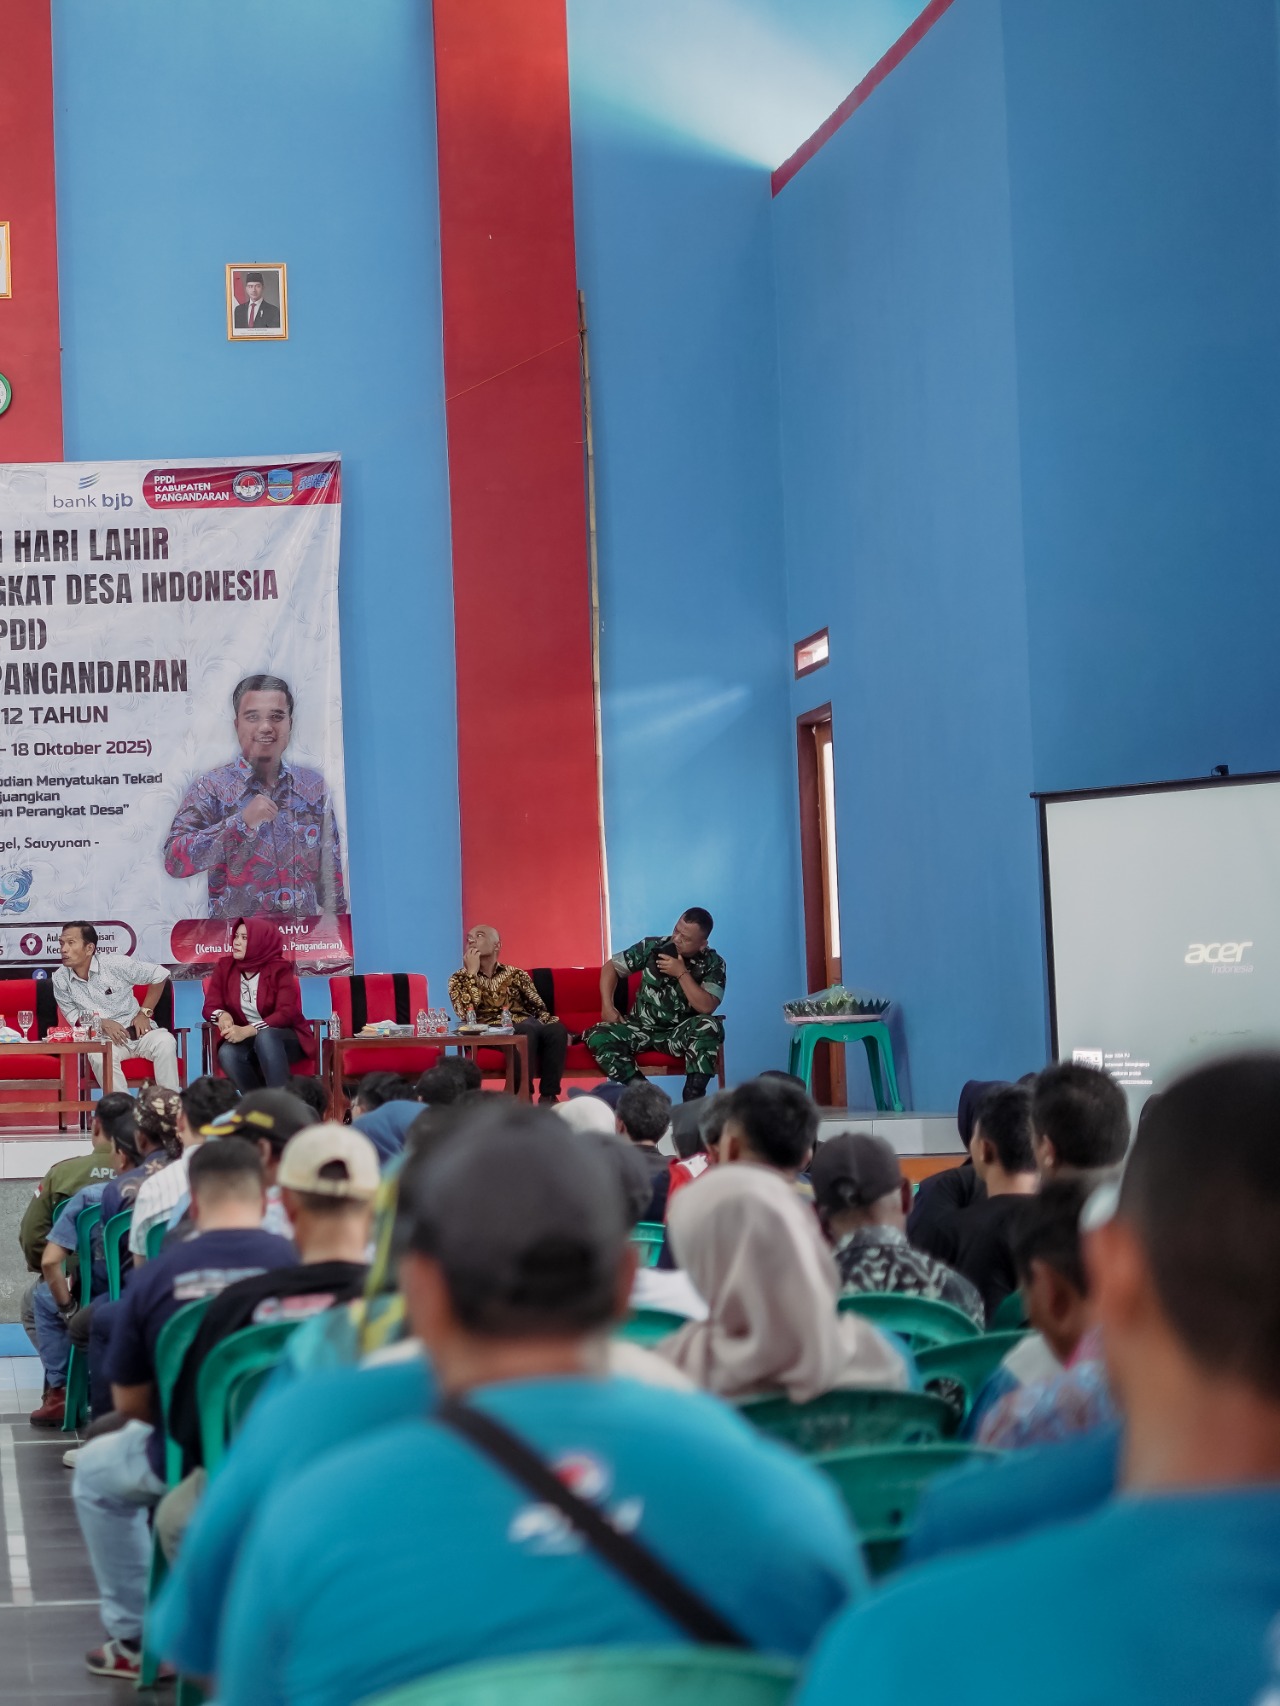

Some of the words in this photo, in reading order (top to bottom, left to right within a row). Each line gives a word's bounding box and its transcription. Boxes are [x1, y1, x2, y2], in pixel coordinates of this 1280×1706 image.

[154, 475, 175, 484] PPDI
[154, 482, 211, 492] KABUPATEN
[53, 494, 97, 508] bank
[102, 493, 133, 511] bjb
[155, 491, 230, 502] PANGANDARAN
[14, 529, 78, 563] HARI
[89, 527, 169, 561] LAHIR
[66, 573, 132, 605] DESA
[142, 569, 279, 603] INDONESIA
[1, 707, 23, 725] 12
[29, 705, 109, 724] TAHUN
[11, 742, 29, 756] 18
[34, 741, 102, 756] Oktober
[106, 739, 152, 757] 2025)
[36, 774, 120, 788] Menyatukan
[122, 773, 163, 785] Tekad
[16, 805, 86, 818] Perangkat
[24, 837, 91, 851] Sauyunan
[98, 932, 115, 941] isari
[278, 925, 309, 935] AHYU
[96, 946, 118, 955] gugur
[195, 943, 222, 955] (Ketua
[290, 939, 343, 953] Pangandaran)
[1184, 941, 1253, 964] acer
